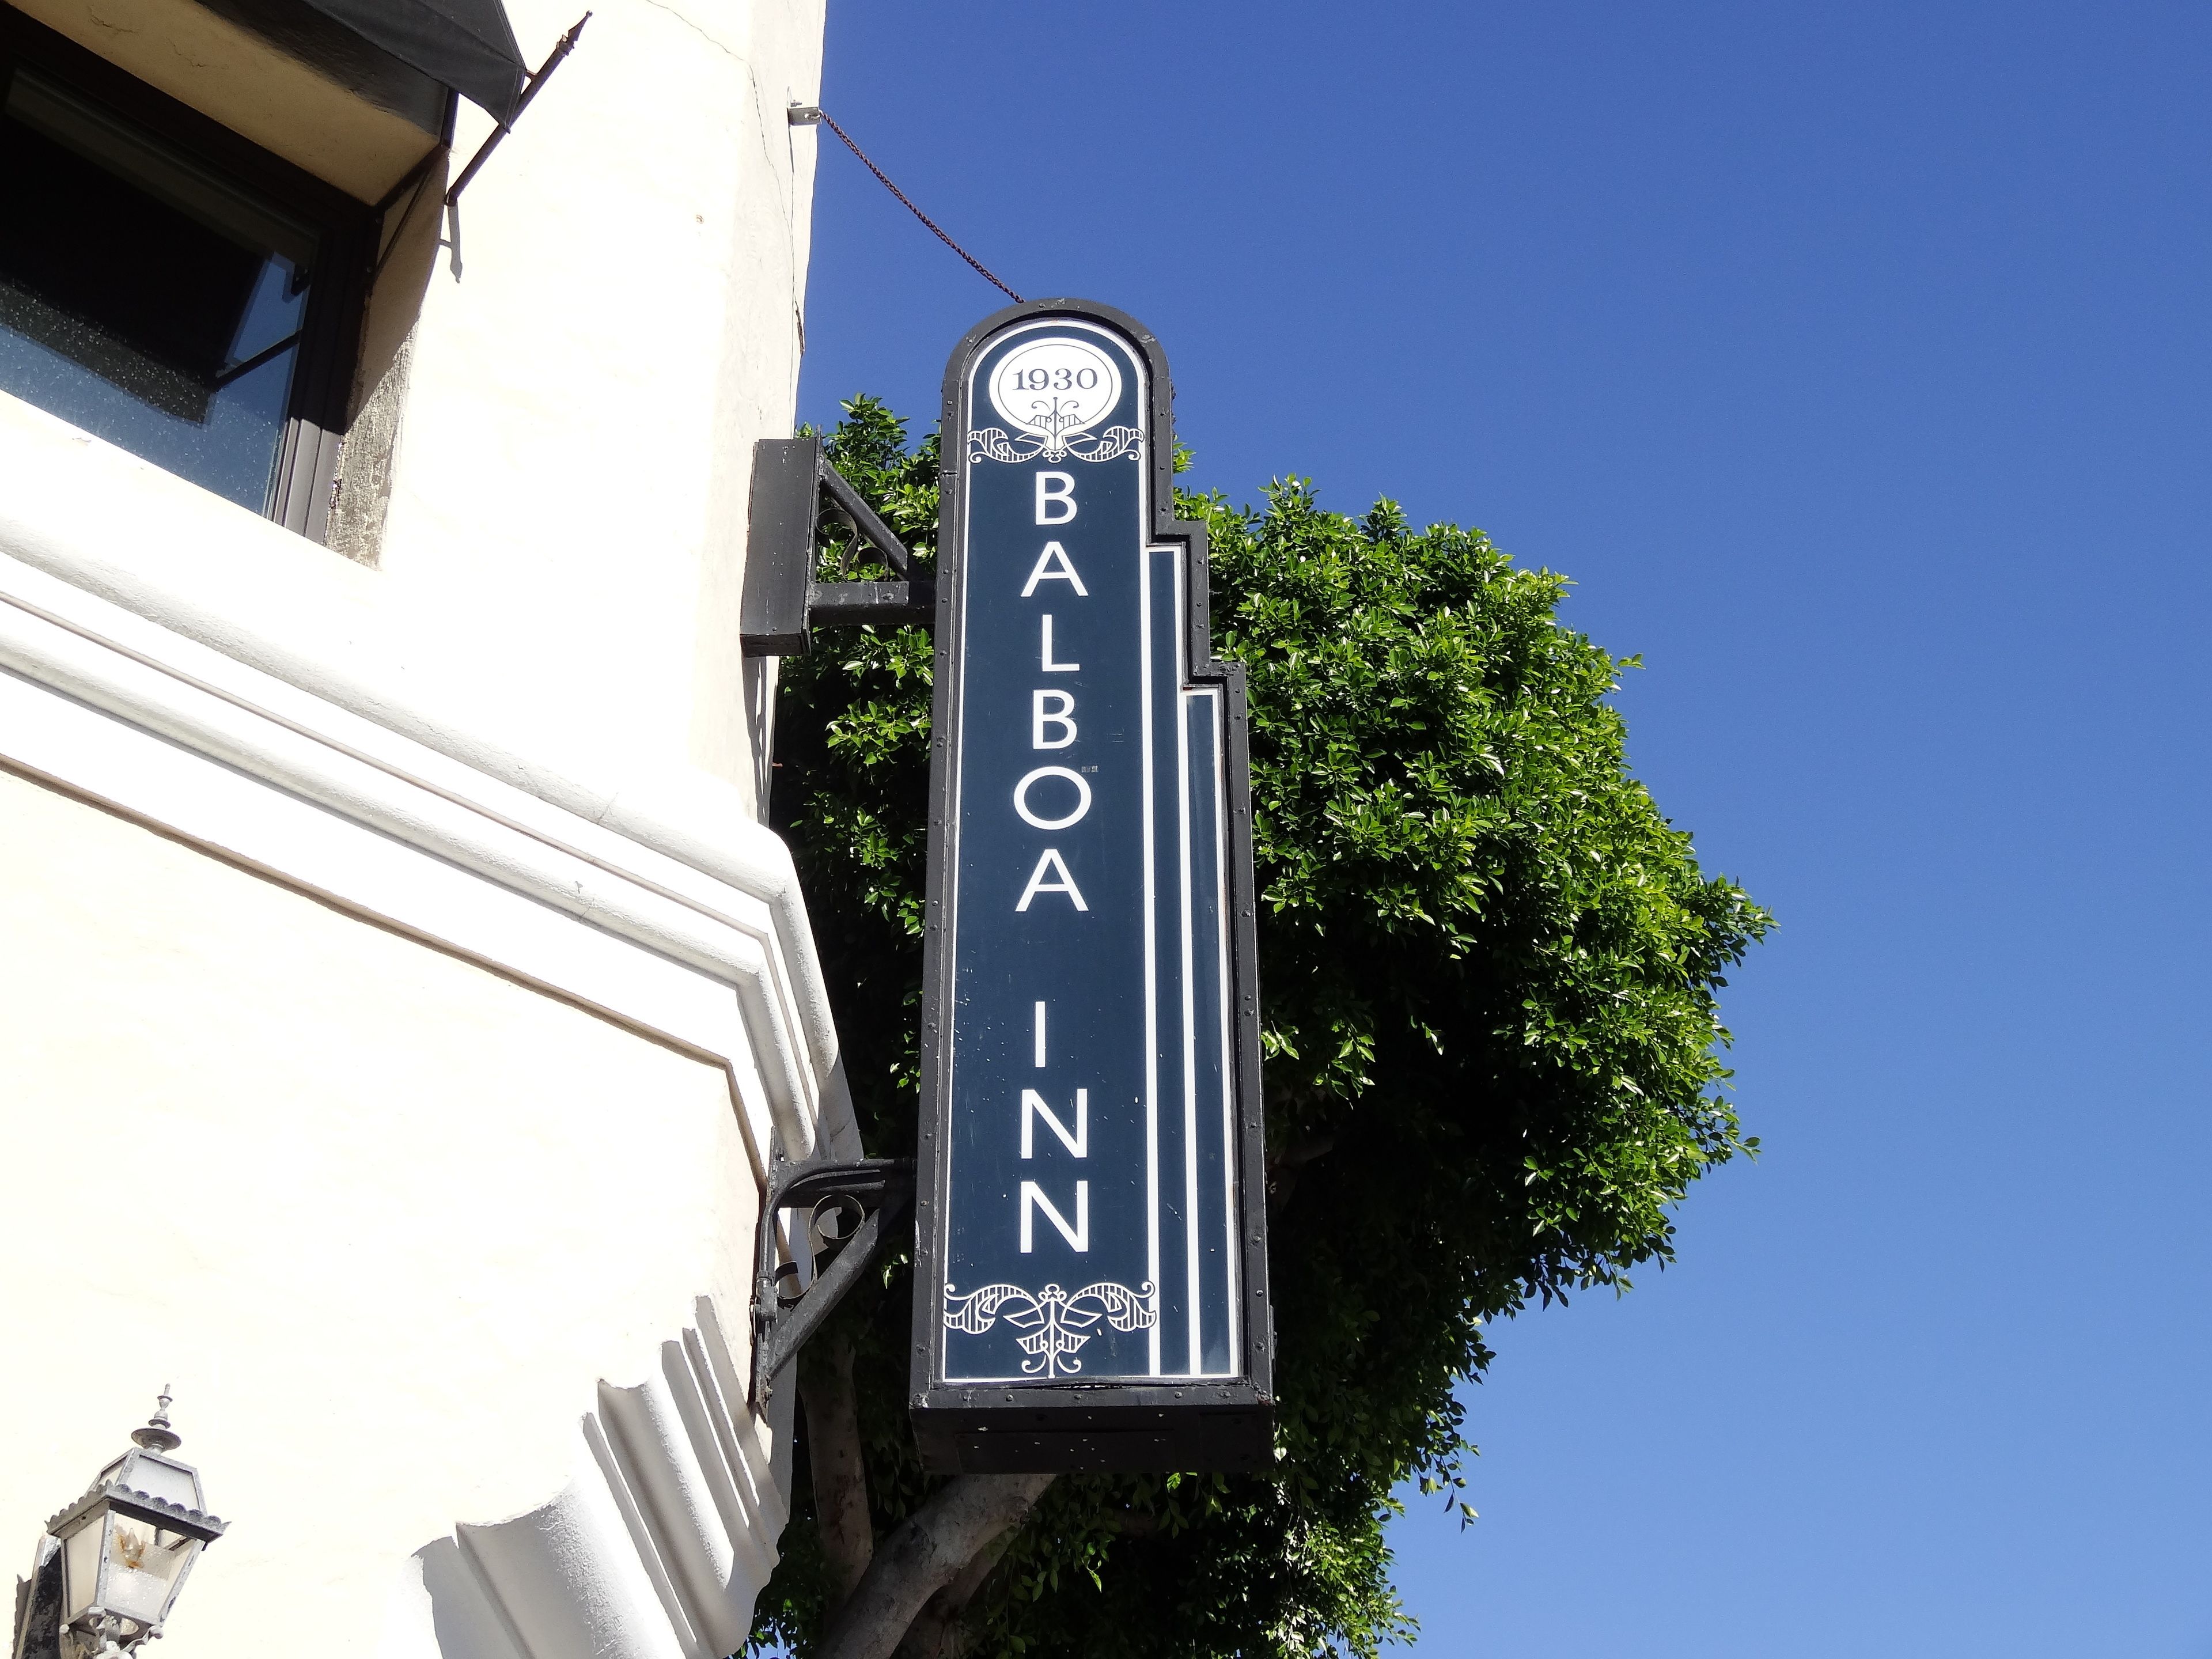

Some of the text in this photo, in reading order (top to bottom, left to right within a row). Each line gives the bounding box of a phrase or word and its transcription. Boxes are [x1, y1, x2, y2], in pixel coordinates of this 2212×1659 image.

[1013, 368, 1098, 391] 1930
[1014, 471, 1092, 1253] BALBOA INN
